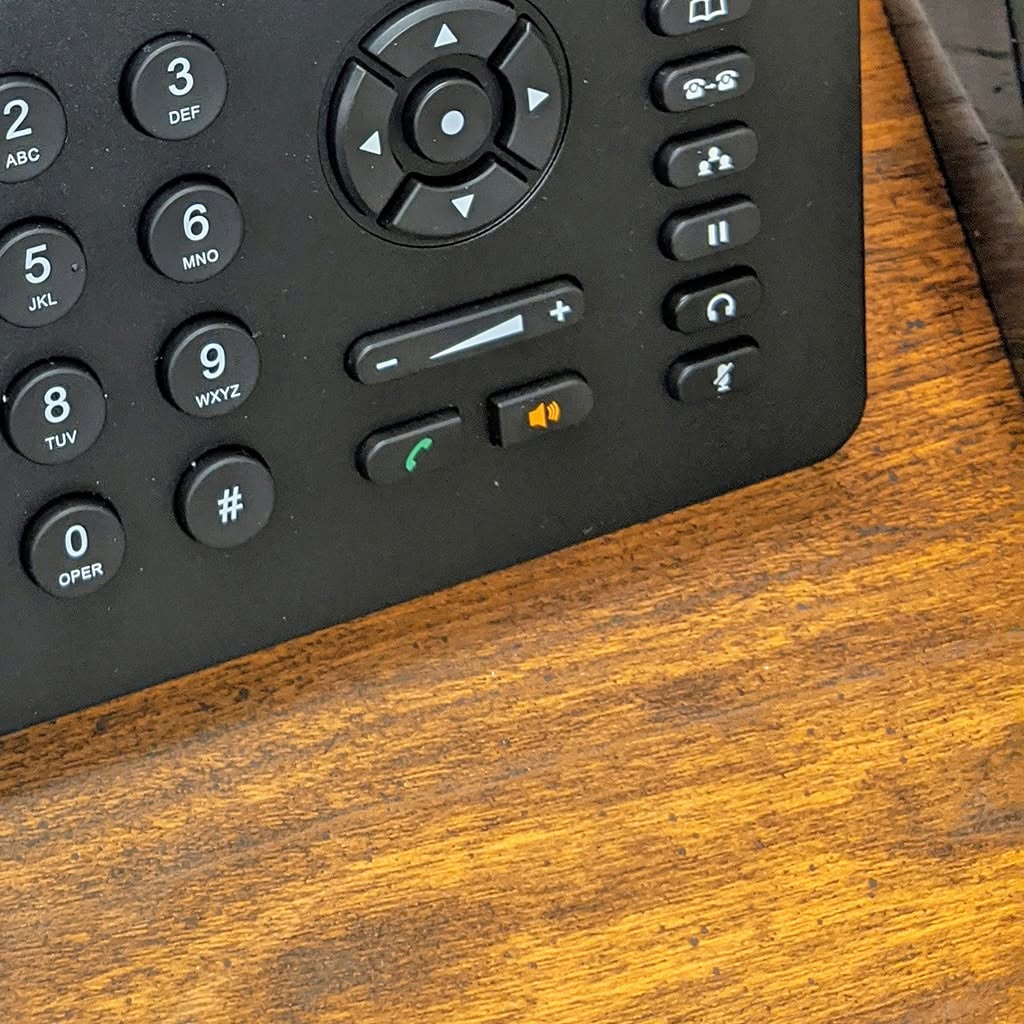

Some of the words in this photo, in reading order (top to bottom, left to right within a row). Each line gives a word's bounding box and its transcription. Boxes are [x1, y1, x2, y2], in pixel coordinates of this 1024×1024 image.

[167, 56, 194, 96] 3
[3, 99, 33, 141] 2
[168, 104, 201, 125] DEF
[5, 147, 41, 169] ABC
[183, 203, 210, 242] 6
[24, 243, 51, 284] 5
[182, 248, 219, 271] MNO
[28, 292, 58, 312] JKL
[199, 342, 226, 380] 9
[43, 385, 71, 424] 8
[195, 383, 242, 409] WXYZ
[44, 429, 77, 451] TUV
[64, 524, 88, 558] 0
[58, 562, 104, 587] OPER
